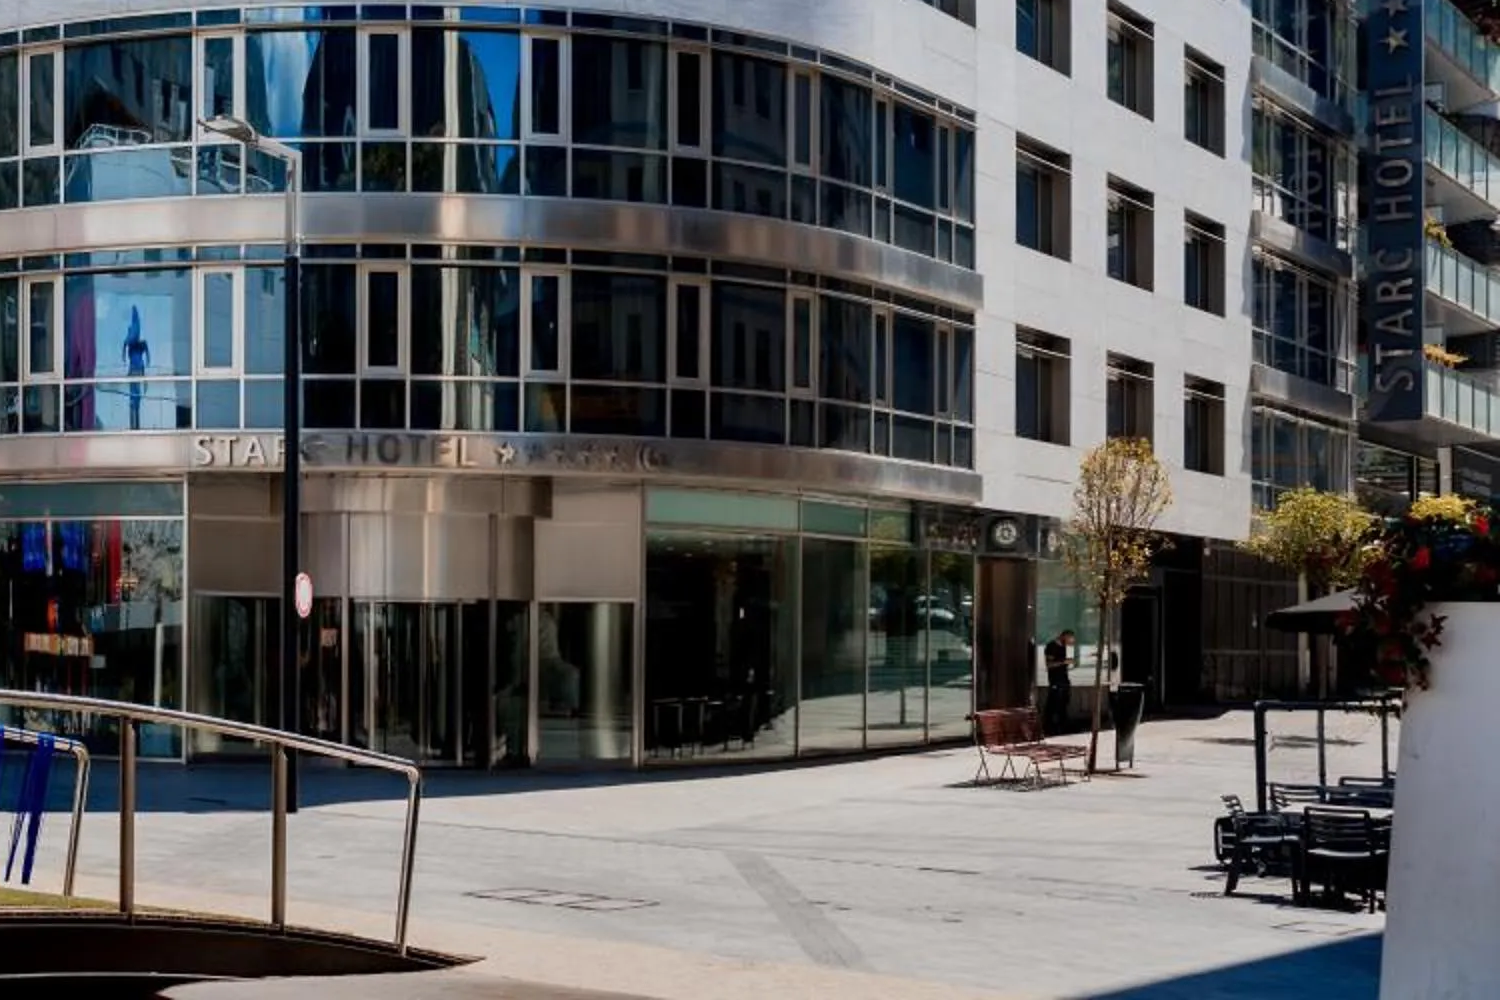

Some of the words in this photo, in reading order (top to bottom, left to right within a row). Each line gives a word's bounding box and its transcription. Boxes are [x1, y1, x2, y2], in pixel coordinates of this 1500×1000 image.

[1375, 73, 1413, 221] HOTEL
[1375, 248, 1414, 391] STARC
[345, 433, 479, 468] HOTEL
